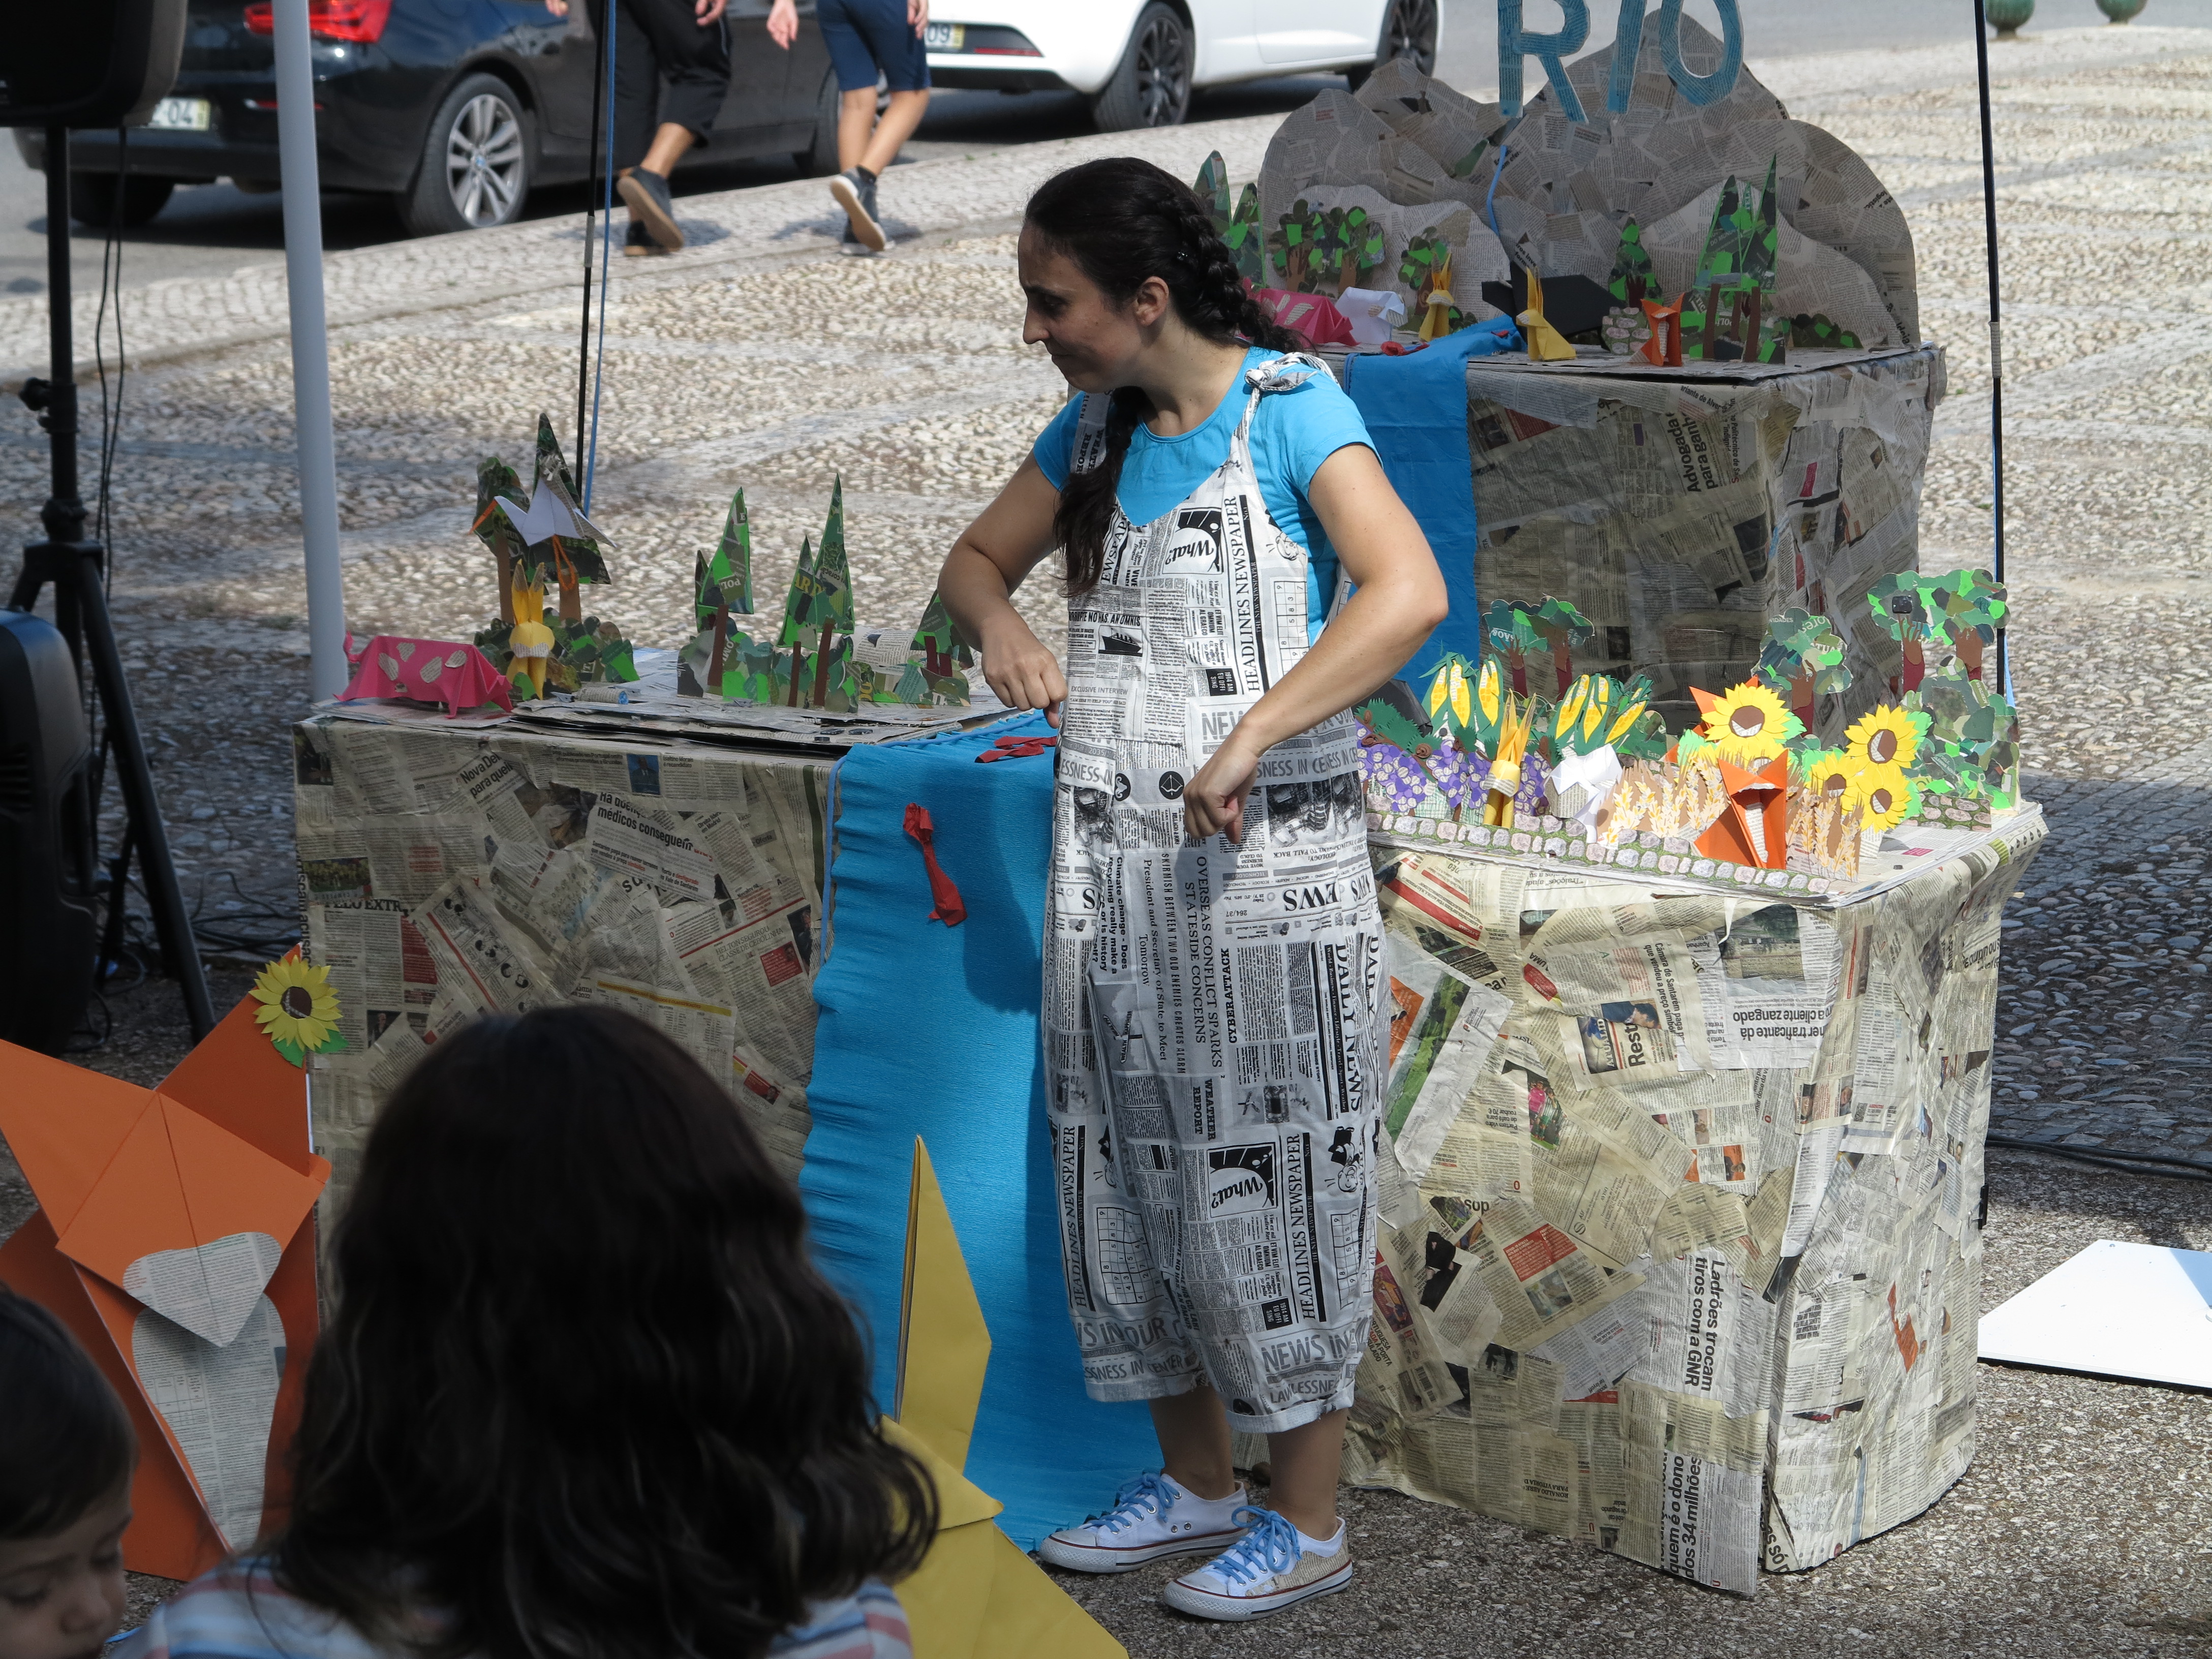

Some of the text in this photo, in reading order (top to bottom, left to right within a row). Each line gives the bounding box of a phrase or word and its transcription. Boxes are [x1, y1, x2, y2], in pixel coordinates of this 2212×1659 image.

[1698, 454, 1718, 489] para
[1165, 539, 1214, 565] What?
[1224, 496, 1249, 595] NEWSPAPER
[1251, 562, 1259, 605] NEWSPAPER
[1120, 615, 1141, 627] OMNIS
[1207, 611, 1215, 633] OMNIUM
[1237, 599, 1261, 692] HEADLINES
[1097, 687, 1128, 695] INTERVIEW
[1227, 682, 1234, 692] AM
[460, 762, 486, 784] Nova
[1298, 758, 1309, 775] IN
[470, 780, 493, 799] para
[597, 807, 637, 830] médicos
[1144, 859, 1154, 907] President
[1118, 899, 1126, 936] change
[1099, 936, 1108, 971] history
[1139, 934, 1150, 987] Tomorrow
[1151, 930, 1162, 978] Secretary
[1162, 853, 1186, 1073] SKIRMISH BETWEEN TWO OLD ENEMIES CREATES ALARM
[1185, 882, 1206, 1043] STATESIDE CONCERNS
[1197, 856, 1222, 1068] OVERSEAS CONFLICT SPARKS
[1529, 951, 1547, 968] UMA
[1643, 944, 1654, 958] que
[1650, 957, 1663, 981] vendeu
[1156, 980, 1162, 991] of
[1220, 947, 1238, 1043] CYBERATTACK
[1656, 988, 1670, 1009] preço
[1156, 993, 1165, 1020] State
[1664, 968, 1683, 1032] de Santarém paga
[1733, 1008, 1783, 1025] zangado
[1783, 1009, 1817, 1024] cliente
[1740, 1026, 1807, 1041] traficante dá
[1159, 1034, 1168, 1061] Meet
[1192, 1086, 1204, 1135] REPORT
[1205, 1078, 1216, 1142] WEATHER
[1500, 1122, 1518, 1130] Partem
[1062, 1126, 1076, 1217] NEWSPAPER
[1286, 1133, 1305, 1228] NEWSPAPER
[1211, 1176, 1263, 1209] What?
[1463, 1199, 1490, 1216] dos
[1067, 1221, 1087, 1307] HEADLINES
[1255, 1253, 1264, 1271] GRAECO
[1263, 1246, 1271, 1268] OMNIUM
[1292, 1231, 1316, 1320] HEADLINES
[1282, 1312, 1289, 1323] AM
[1684, 1256, 1708, 1387] tiros com a GNR
[1701, 1259, 1726, 1392] Ladrões trocam
[1099, 1316, 1169, 1347] IN OUR
[1130, 1354, 1184, 1376] IN CENTER
[1261, 1334, 1326, 1373] NEWS
[1377, 1346, 1393, 1367] PORTA
[1525, 1485, 1569, 1498] RONALDO ABRE
[1552, 1484, 1569, 1492] PARA
[1667, 1455, 1684, 1575] quem é o dono
[1681, 1456, 1702, 1580] dos 34 milhões
[1768, 1545, 1789, 1565] só
